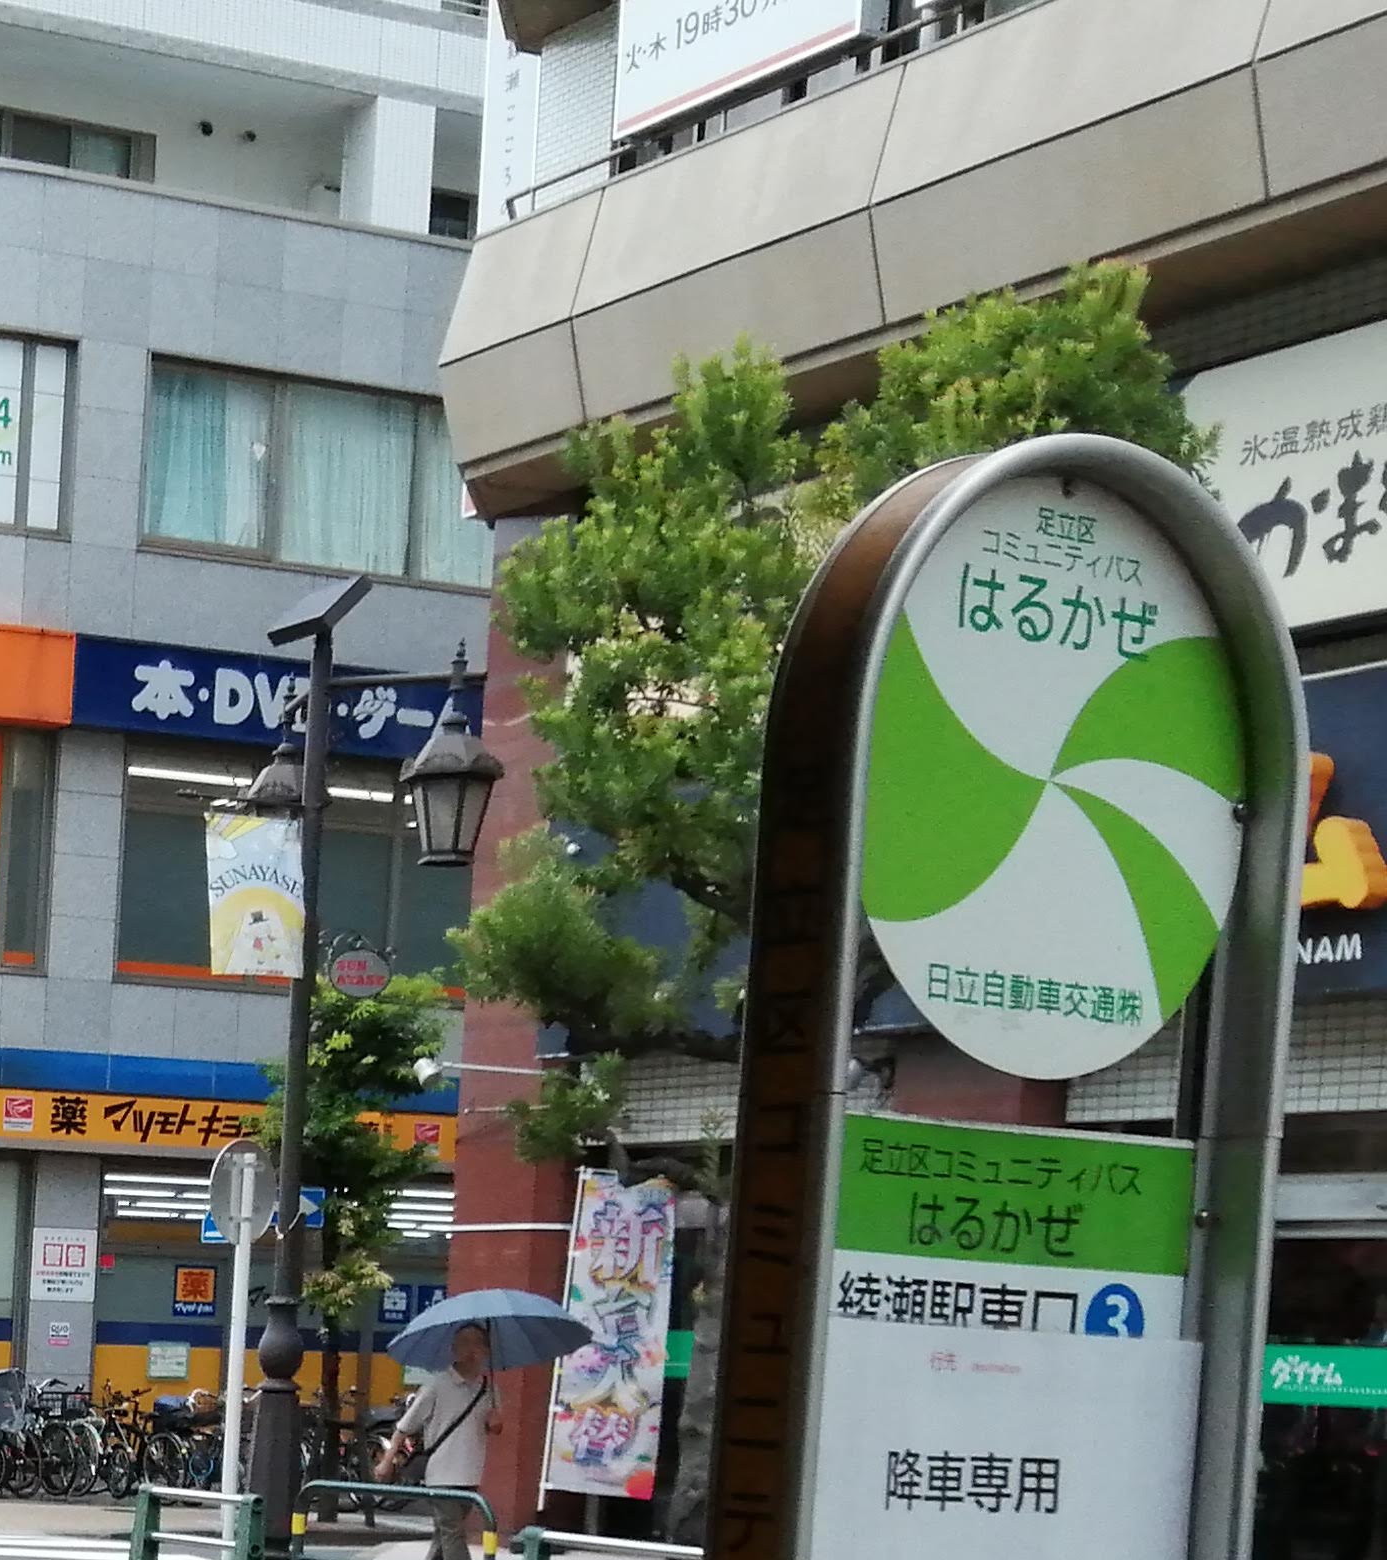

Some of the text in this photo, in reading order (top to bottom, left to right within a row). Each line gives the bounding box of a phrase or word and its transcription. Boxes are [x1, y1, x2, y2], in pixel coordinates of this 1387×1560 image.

[1036, 506, 1097, 545] 足立区
[1237, 450, 1387, 578] かま
[981, 529, 1143, 583] コミュニティバス
[958, 562, 1160, 662] はるかぜ
[208, 863, 302, 900] SUNAYASE
[336, 960, 368, 972] SUN
[49, 1095, 89, 1137] 薬
[859, 1136, 1145, 1197] 足立区コミュニティバス
[908, 1191, 1083, 1259] はるかぜ
[181, 1270, 211, 1299] 薬
[1269, 1354, 1343, 1389] ダイナム
[883, 1449, 1061, 1516] 降車専用
